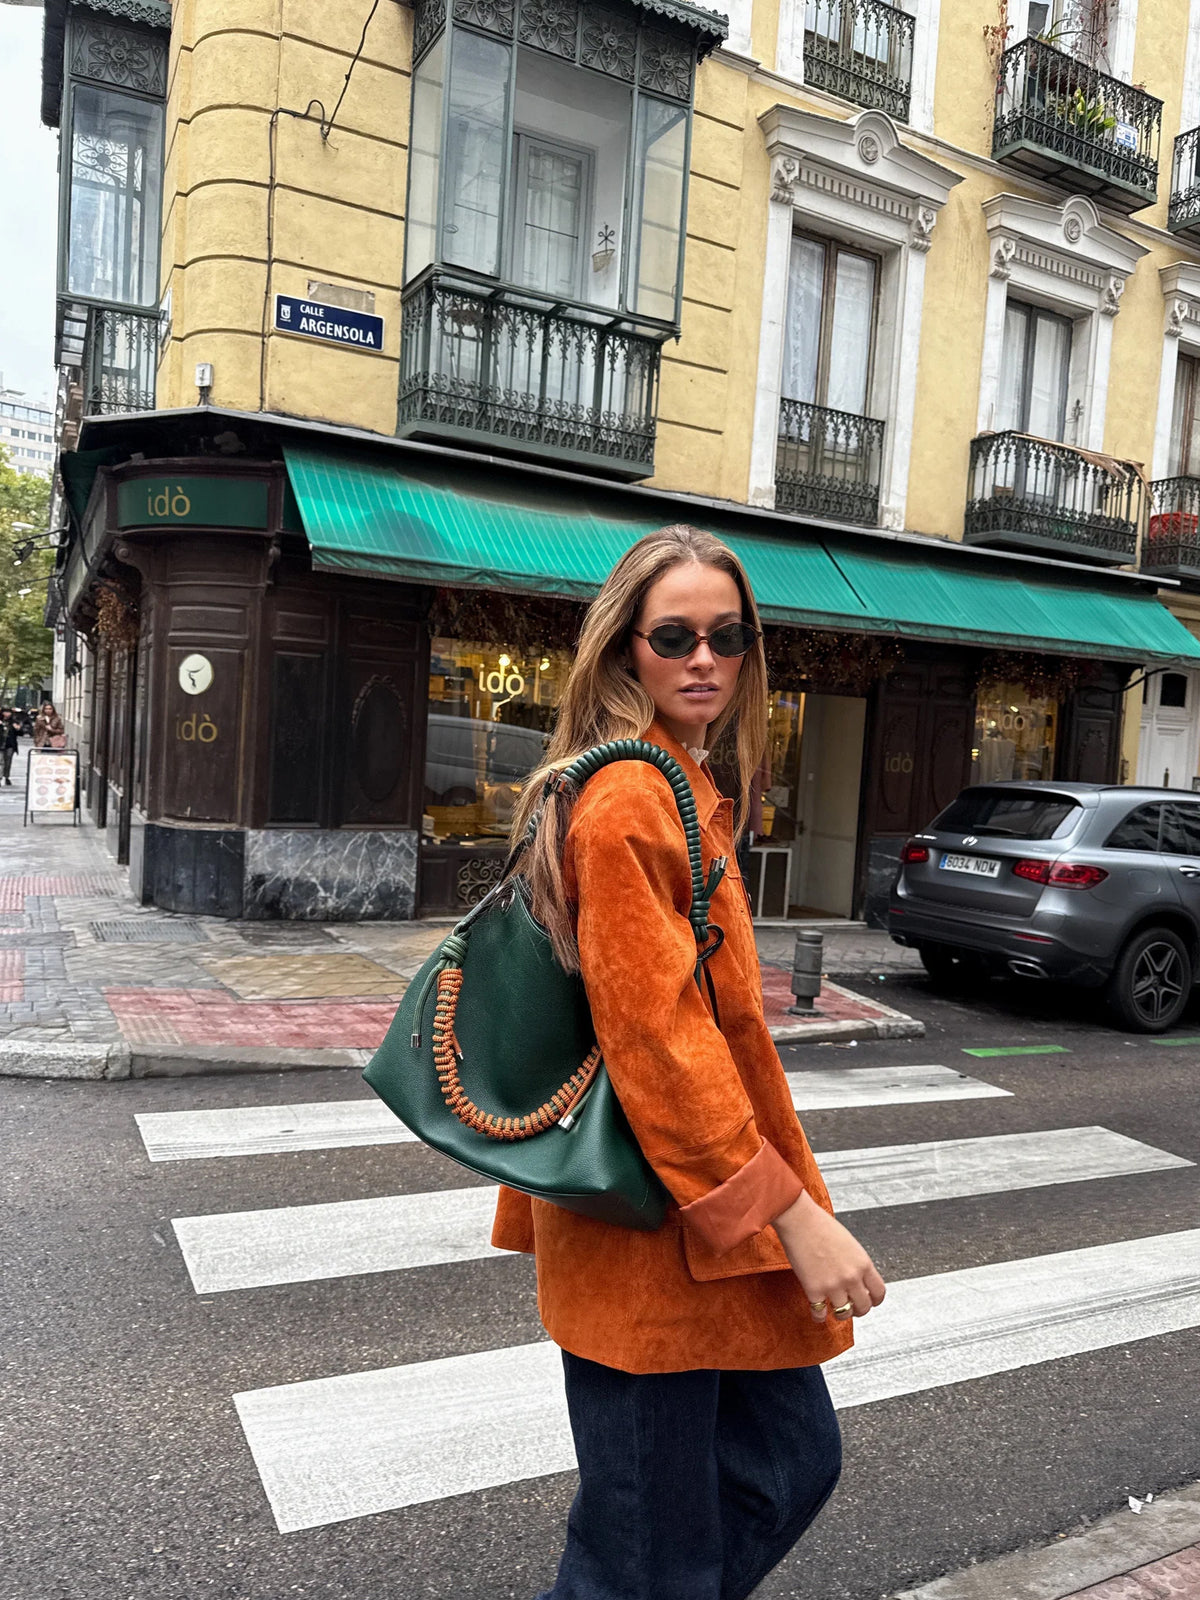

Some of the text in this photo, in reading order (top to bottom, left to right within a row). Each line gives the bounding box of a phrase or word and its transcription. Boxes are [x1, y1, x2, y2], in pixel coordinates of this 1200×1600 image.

[300, 304, 325, 318] CALLE
[299, 317, 375, 345] ARGENSOLA
[148, 486, 191, 516] idò
[478, 663, 525, 695] idò
[176, 713, 218, 742] idò
[884, 752, 914, 774] idò
[946, 856, 997, 874] 6034 NDM
